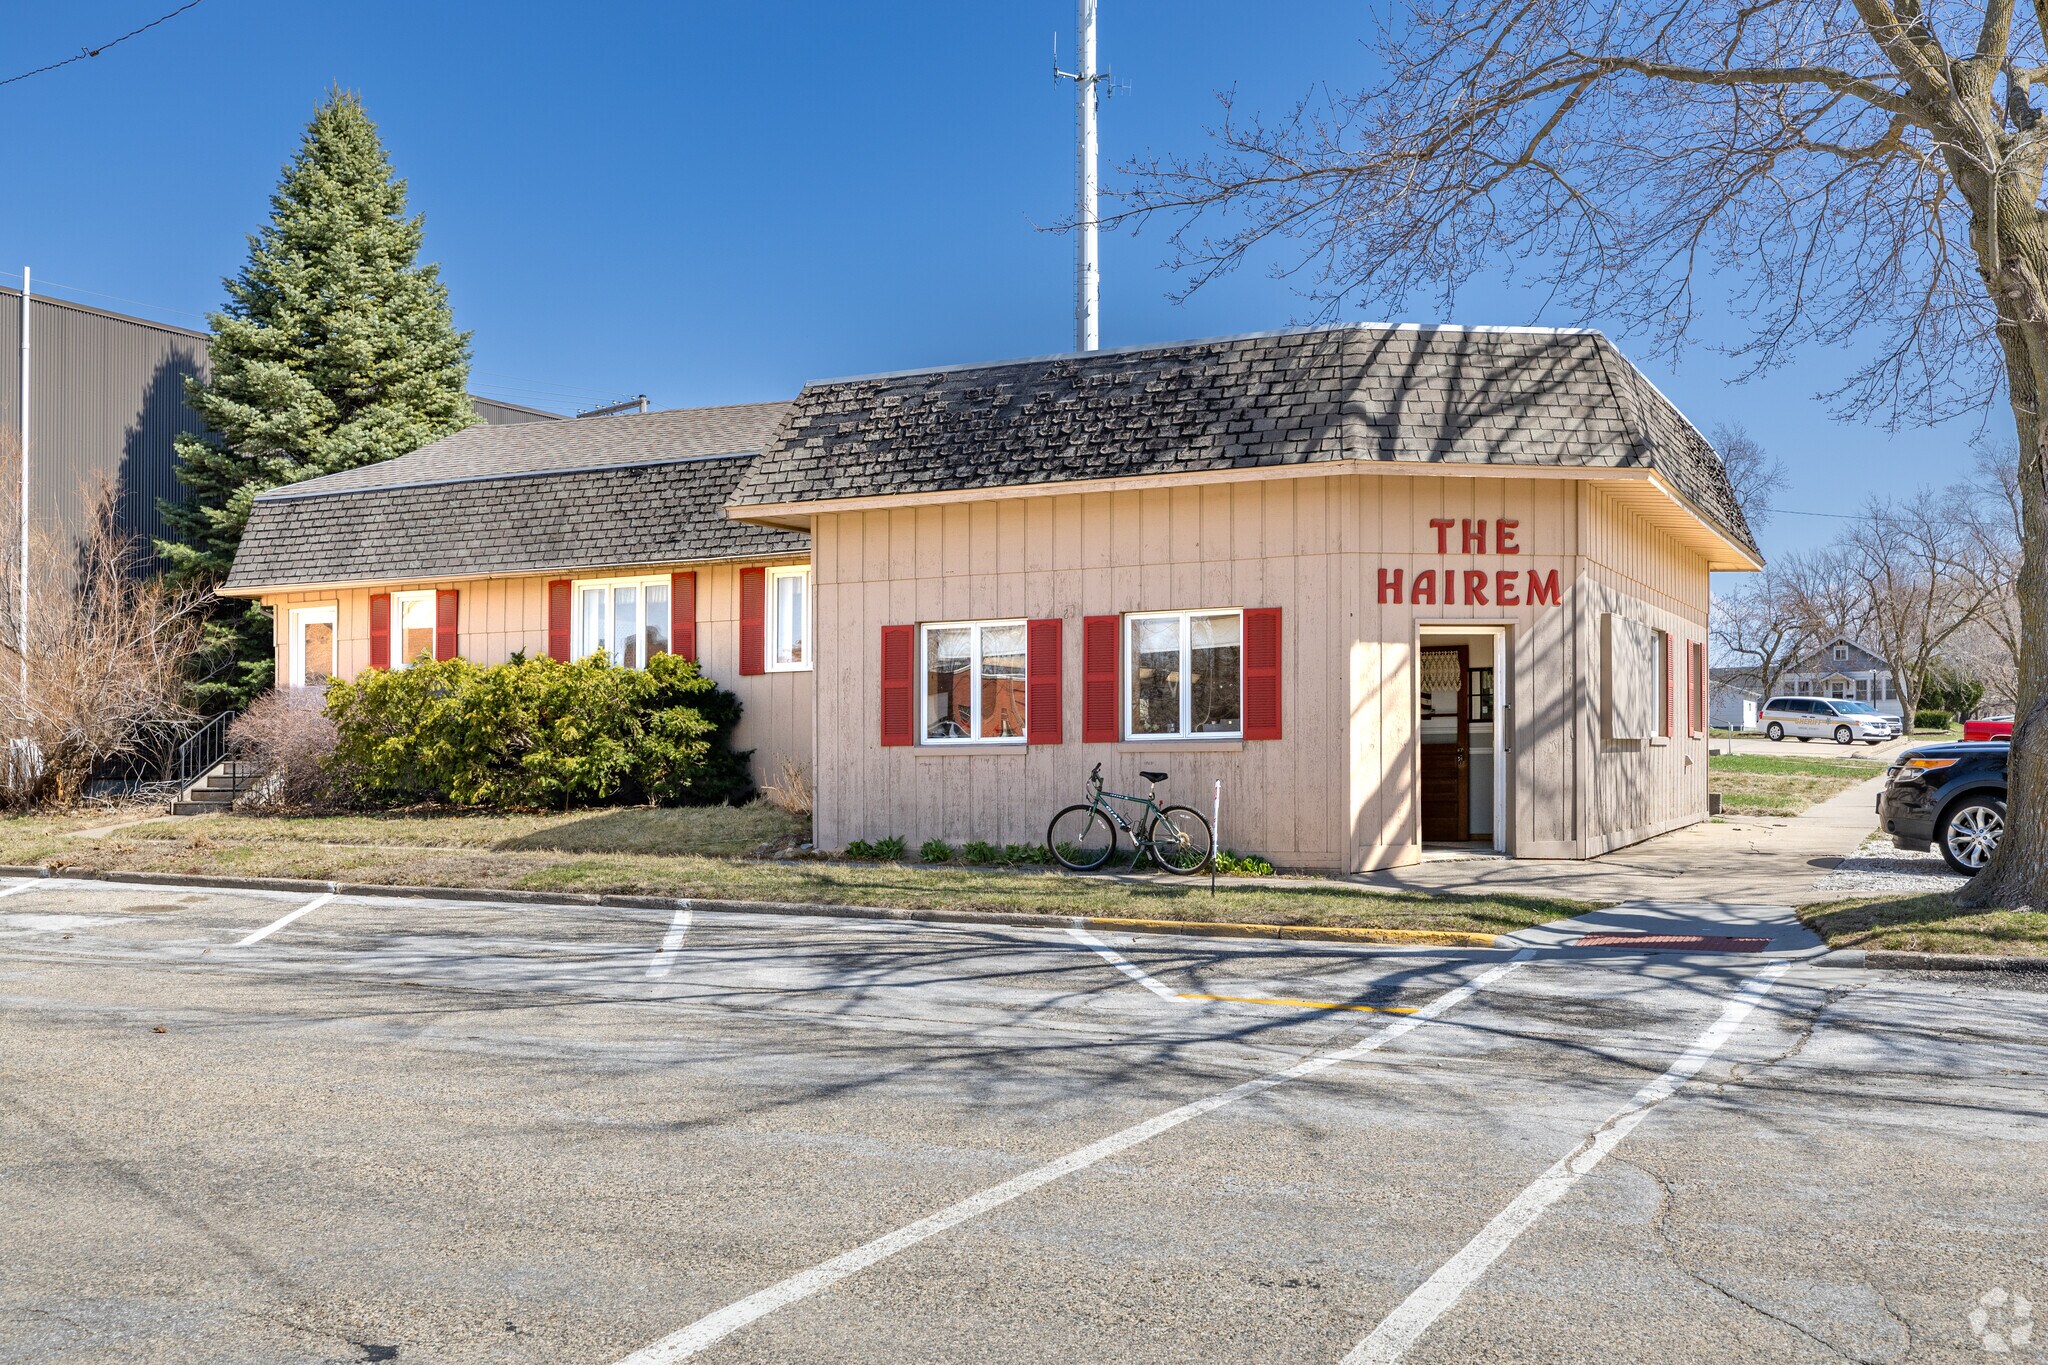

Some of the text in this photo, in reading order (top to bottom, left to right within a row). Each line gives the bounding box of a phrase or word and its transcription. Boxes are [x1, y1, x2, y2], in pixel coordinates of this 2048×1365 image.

[1429, 518, 1520, 554] THE
[1377, 568, 1561, 606] HAIREM
[1794, 717, 1823, 726] SHERIFF
[1105, 804, 1128, 828] GIANT
